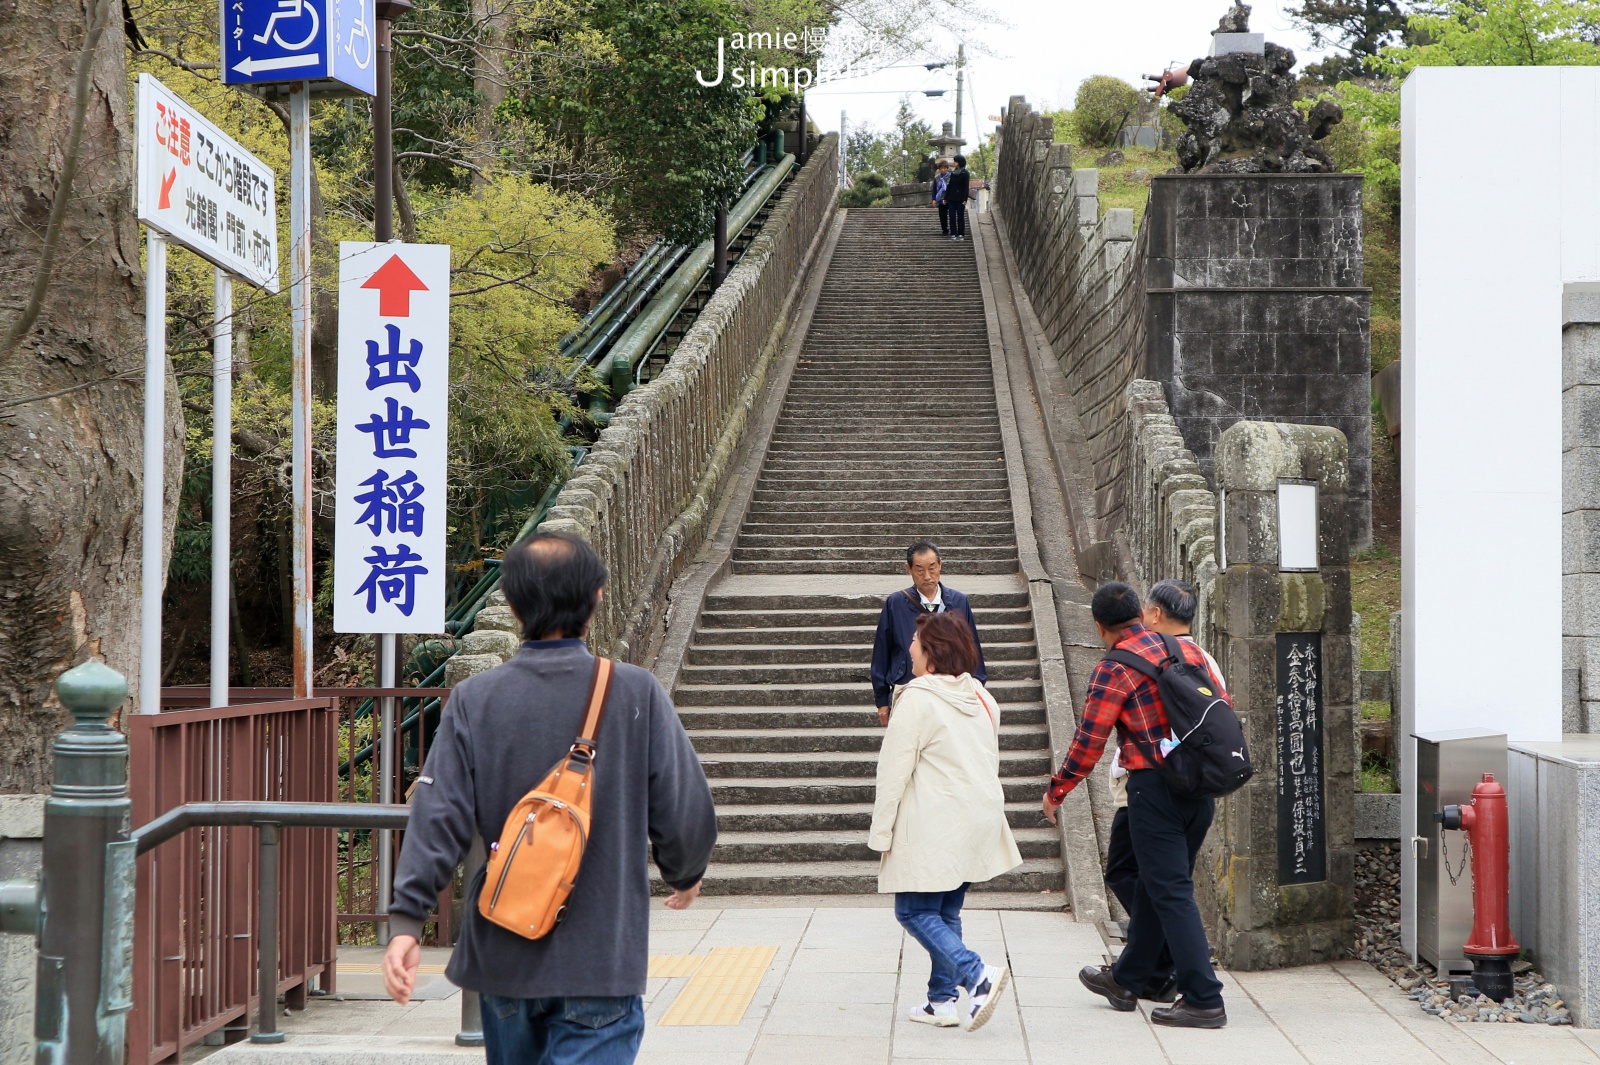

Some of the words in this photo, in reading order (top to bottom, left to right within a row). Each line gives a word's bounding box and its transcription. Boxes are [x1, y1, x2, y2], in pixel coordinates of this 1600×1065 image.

[155, 101, 191, 167] ご注意
[196, 130, 269, 218] ここから階段です
[353, 323, 431, 617] 出世稲荷
